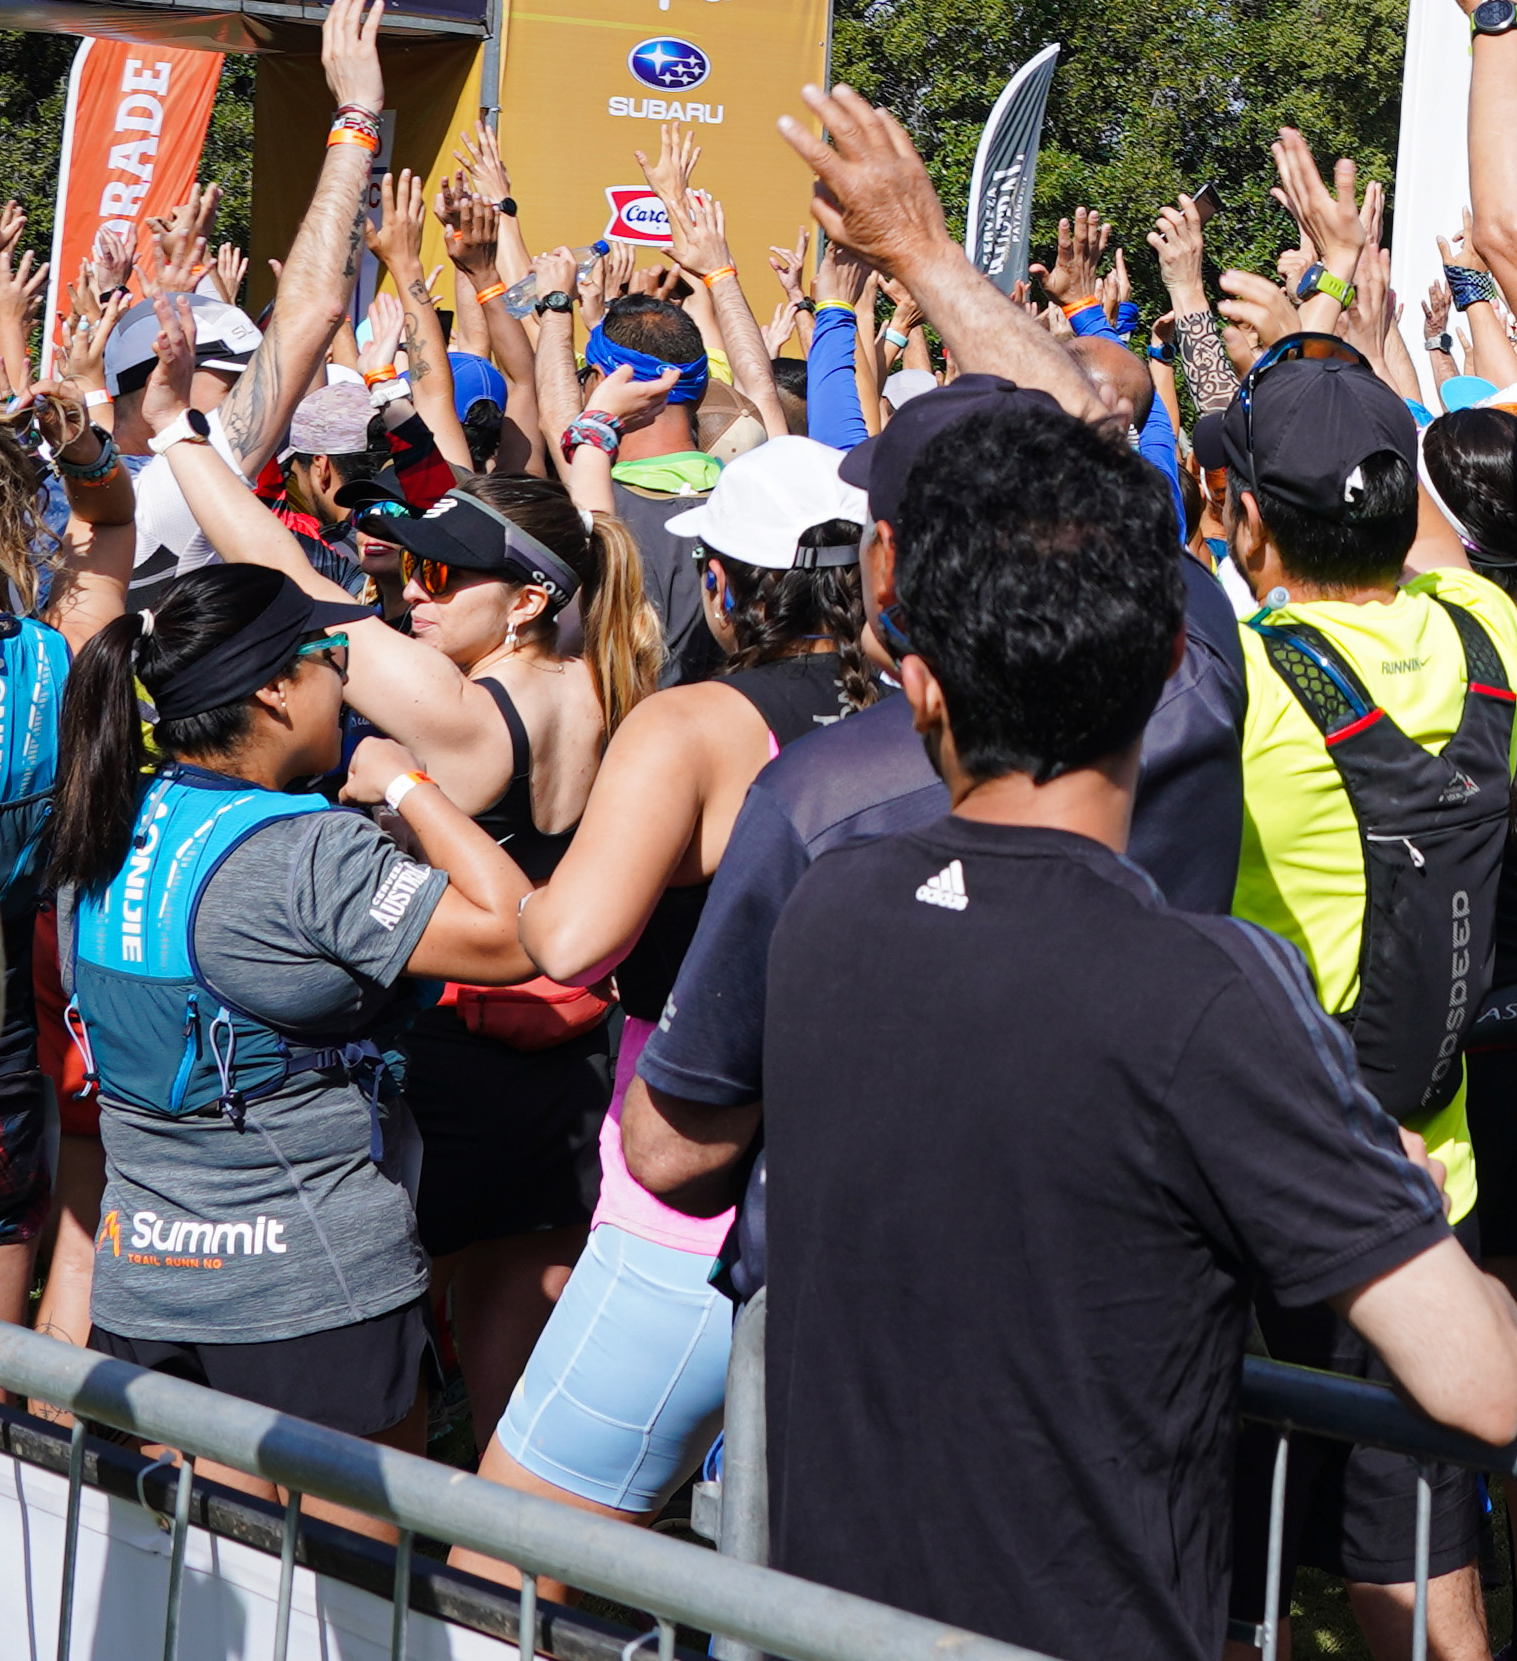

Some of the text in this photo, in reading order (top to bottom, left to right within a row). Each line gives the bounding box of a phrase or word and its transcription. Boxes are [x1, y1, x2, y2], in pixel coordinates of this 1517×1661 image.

[608, 96, 724, 124] SUBARU
[131, 1211, 287, 1255] Summit
[127, 1252, 161, 1267] TRAIL
